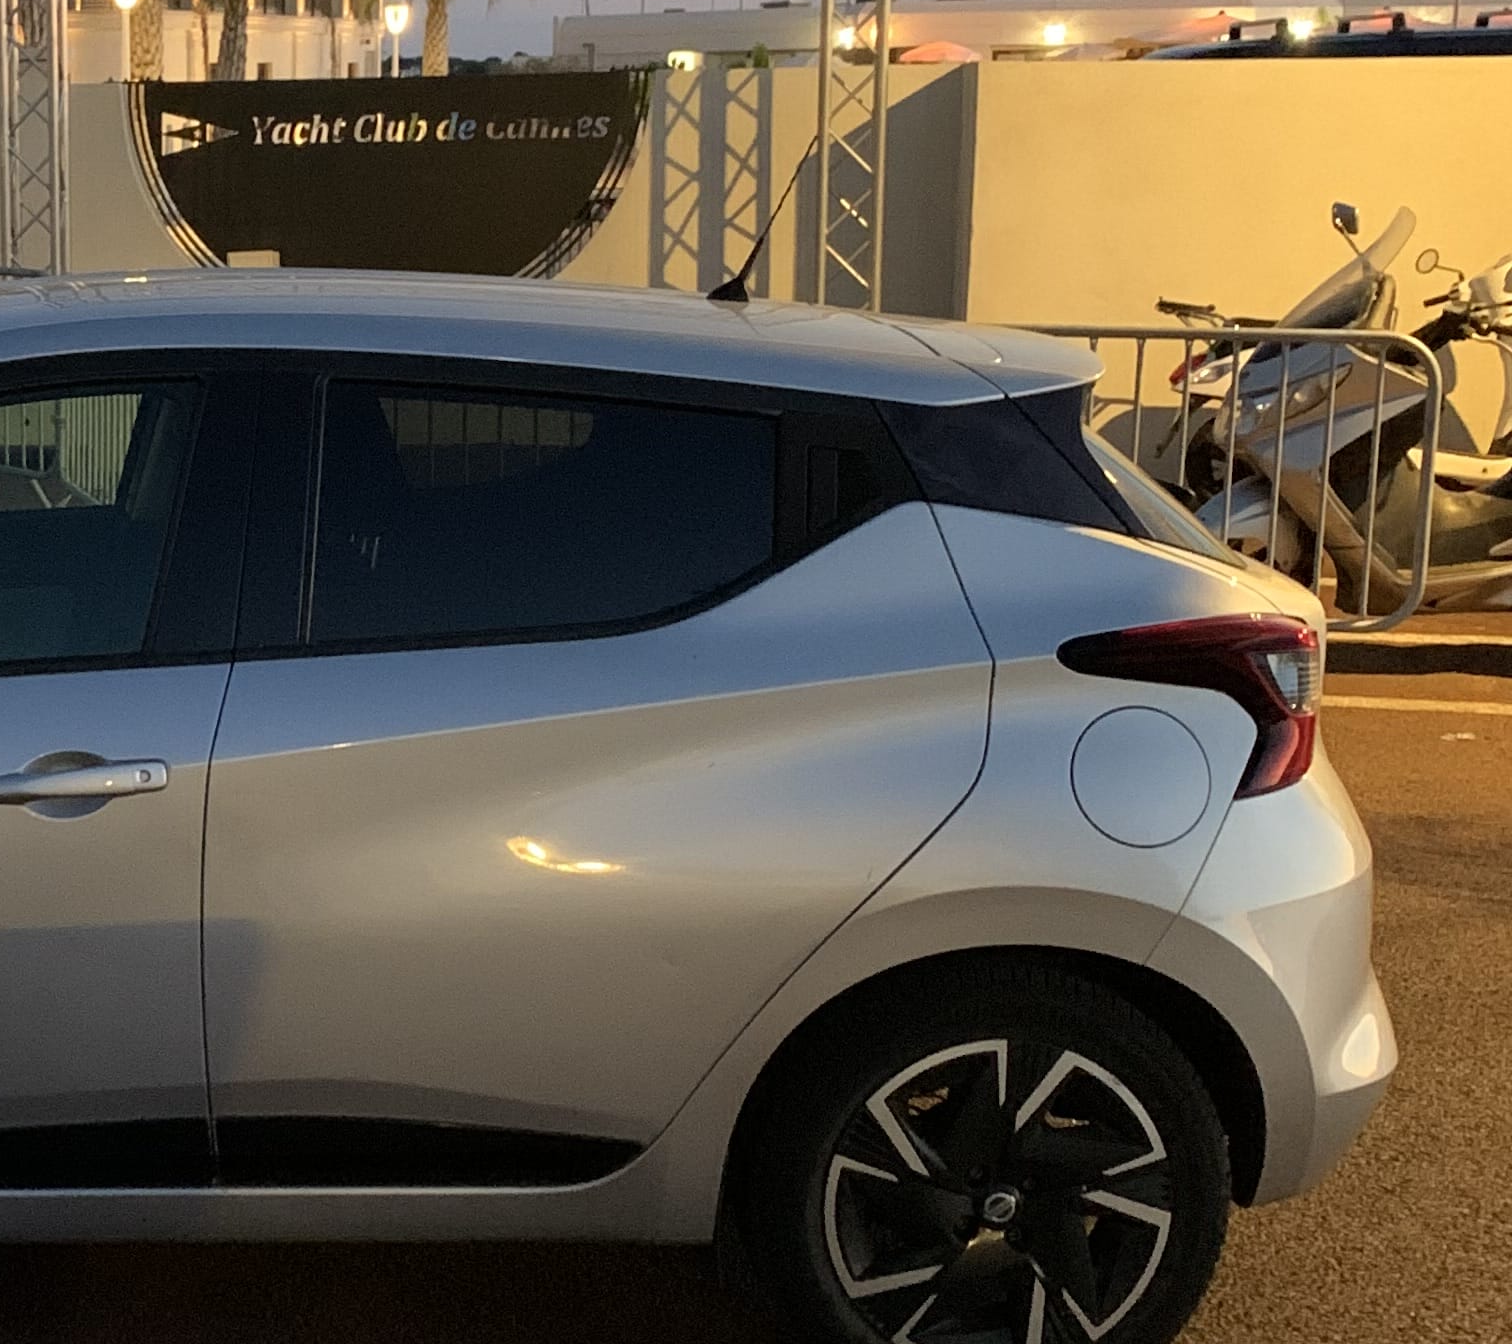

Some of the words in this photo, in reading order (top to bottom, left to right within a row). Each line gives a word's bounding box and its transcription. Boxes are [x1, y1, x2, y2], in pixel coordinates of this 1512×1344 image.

[252, 113, 346, 145] Yacht
[354, 111, 428, 143] Club
[436, 111, 476, 141] de
